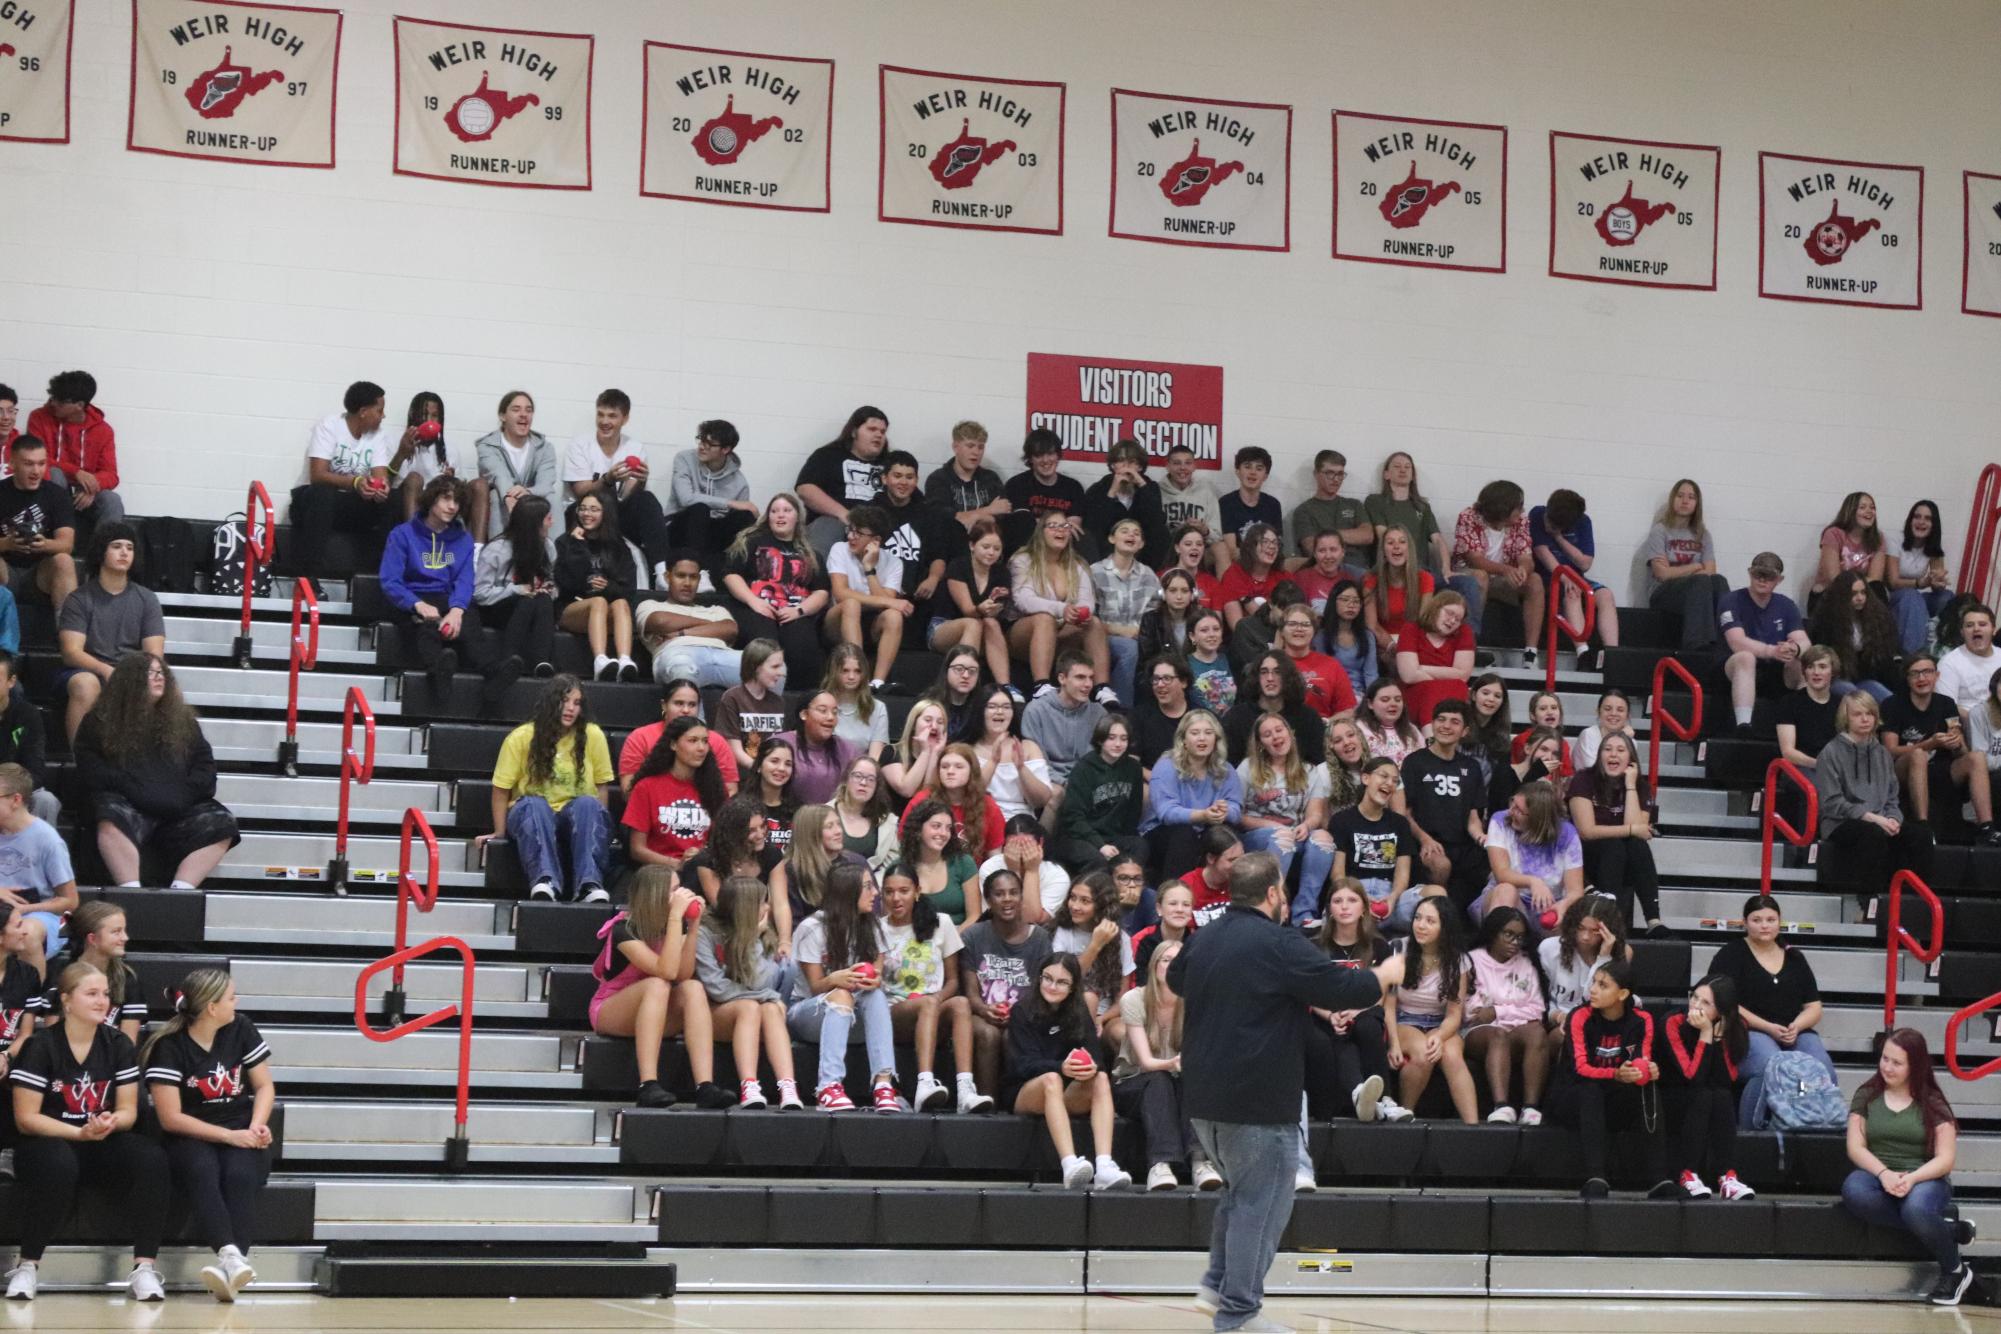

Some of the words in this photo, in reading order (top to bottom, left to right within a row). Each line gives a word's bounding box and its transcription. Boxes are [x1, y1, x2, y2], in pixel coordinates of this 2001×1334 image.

[170, 15, 228, 46] WEIR
[245, 17, 303, 56] HIGH
[20, 57, 39, 71] 96
[429, 41, 485, 72] WEIR
[501, 44, 557, 81] HIGH
[163, 70, 176, 84] 19
[288, 82, 307, 96] 97
[676, 66, 731, 96] WEIR
[746, 67, 800, 105] HIGH
[425, 96, 438, 110] 19
[545, 107, 562, 120] 99
[914, 90, 966, 120] WEIR
[979, 91, 1031, 127] HIGH
[673, 117, 690, 132] 20
[785, 129, 802, 142] 02
[1148, 111, 1196, 139] WEIR
[1206, 112, 1254, 146] HIGH
[186, 130, 277, 151] RUNNER-UP
[1364, 132, 1414, 164] WEIR
[1426, 134, 1476, 170] HIGH
[451, 154, 535, 174] RUNNER-UP
[909, 144, 926, 158] 20
[1019, 153, 1036, 166] 03
[1138, 162, 1154, 176] 20
[1247, 172, 1263, 185] 04
[1580, 152, 1628, 181] WEIR
[1640, 154, 1688, 189] HIGH
[695, 177, 777, 197] RUNNER-UP
[1361, 182, 1376, 196] 20
[1465, 191, 1481, 205] 05
[1788, 173, 1836, 202] WEIR
[1848, 176, 1894, 210] HIGH
[932, 201, 1012, 218] RUNNER-UP
[1578, 202, 1593, 216] 20
[1678, 212, 1692, 225] 05
[1164, 218, 1235, 235] RUNNER-UP
[1612, 218, 1631, 230] BOYS
[1785, 225, 1800, 238] 20
[1882, 234, 1897, 247] 08
[1383, 240, 1454, 258] RUNNER-UP
[1600, 257, 1668, 275] RUNNER-UP
[1807, 276, 1877, 293] RUNNER-UP
[1079, 366, 1173, 409] VISITORS
[1132, 419, 1218, 460] SECTION
[1434, 774, 1461, 797] 35
